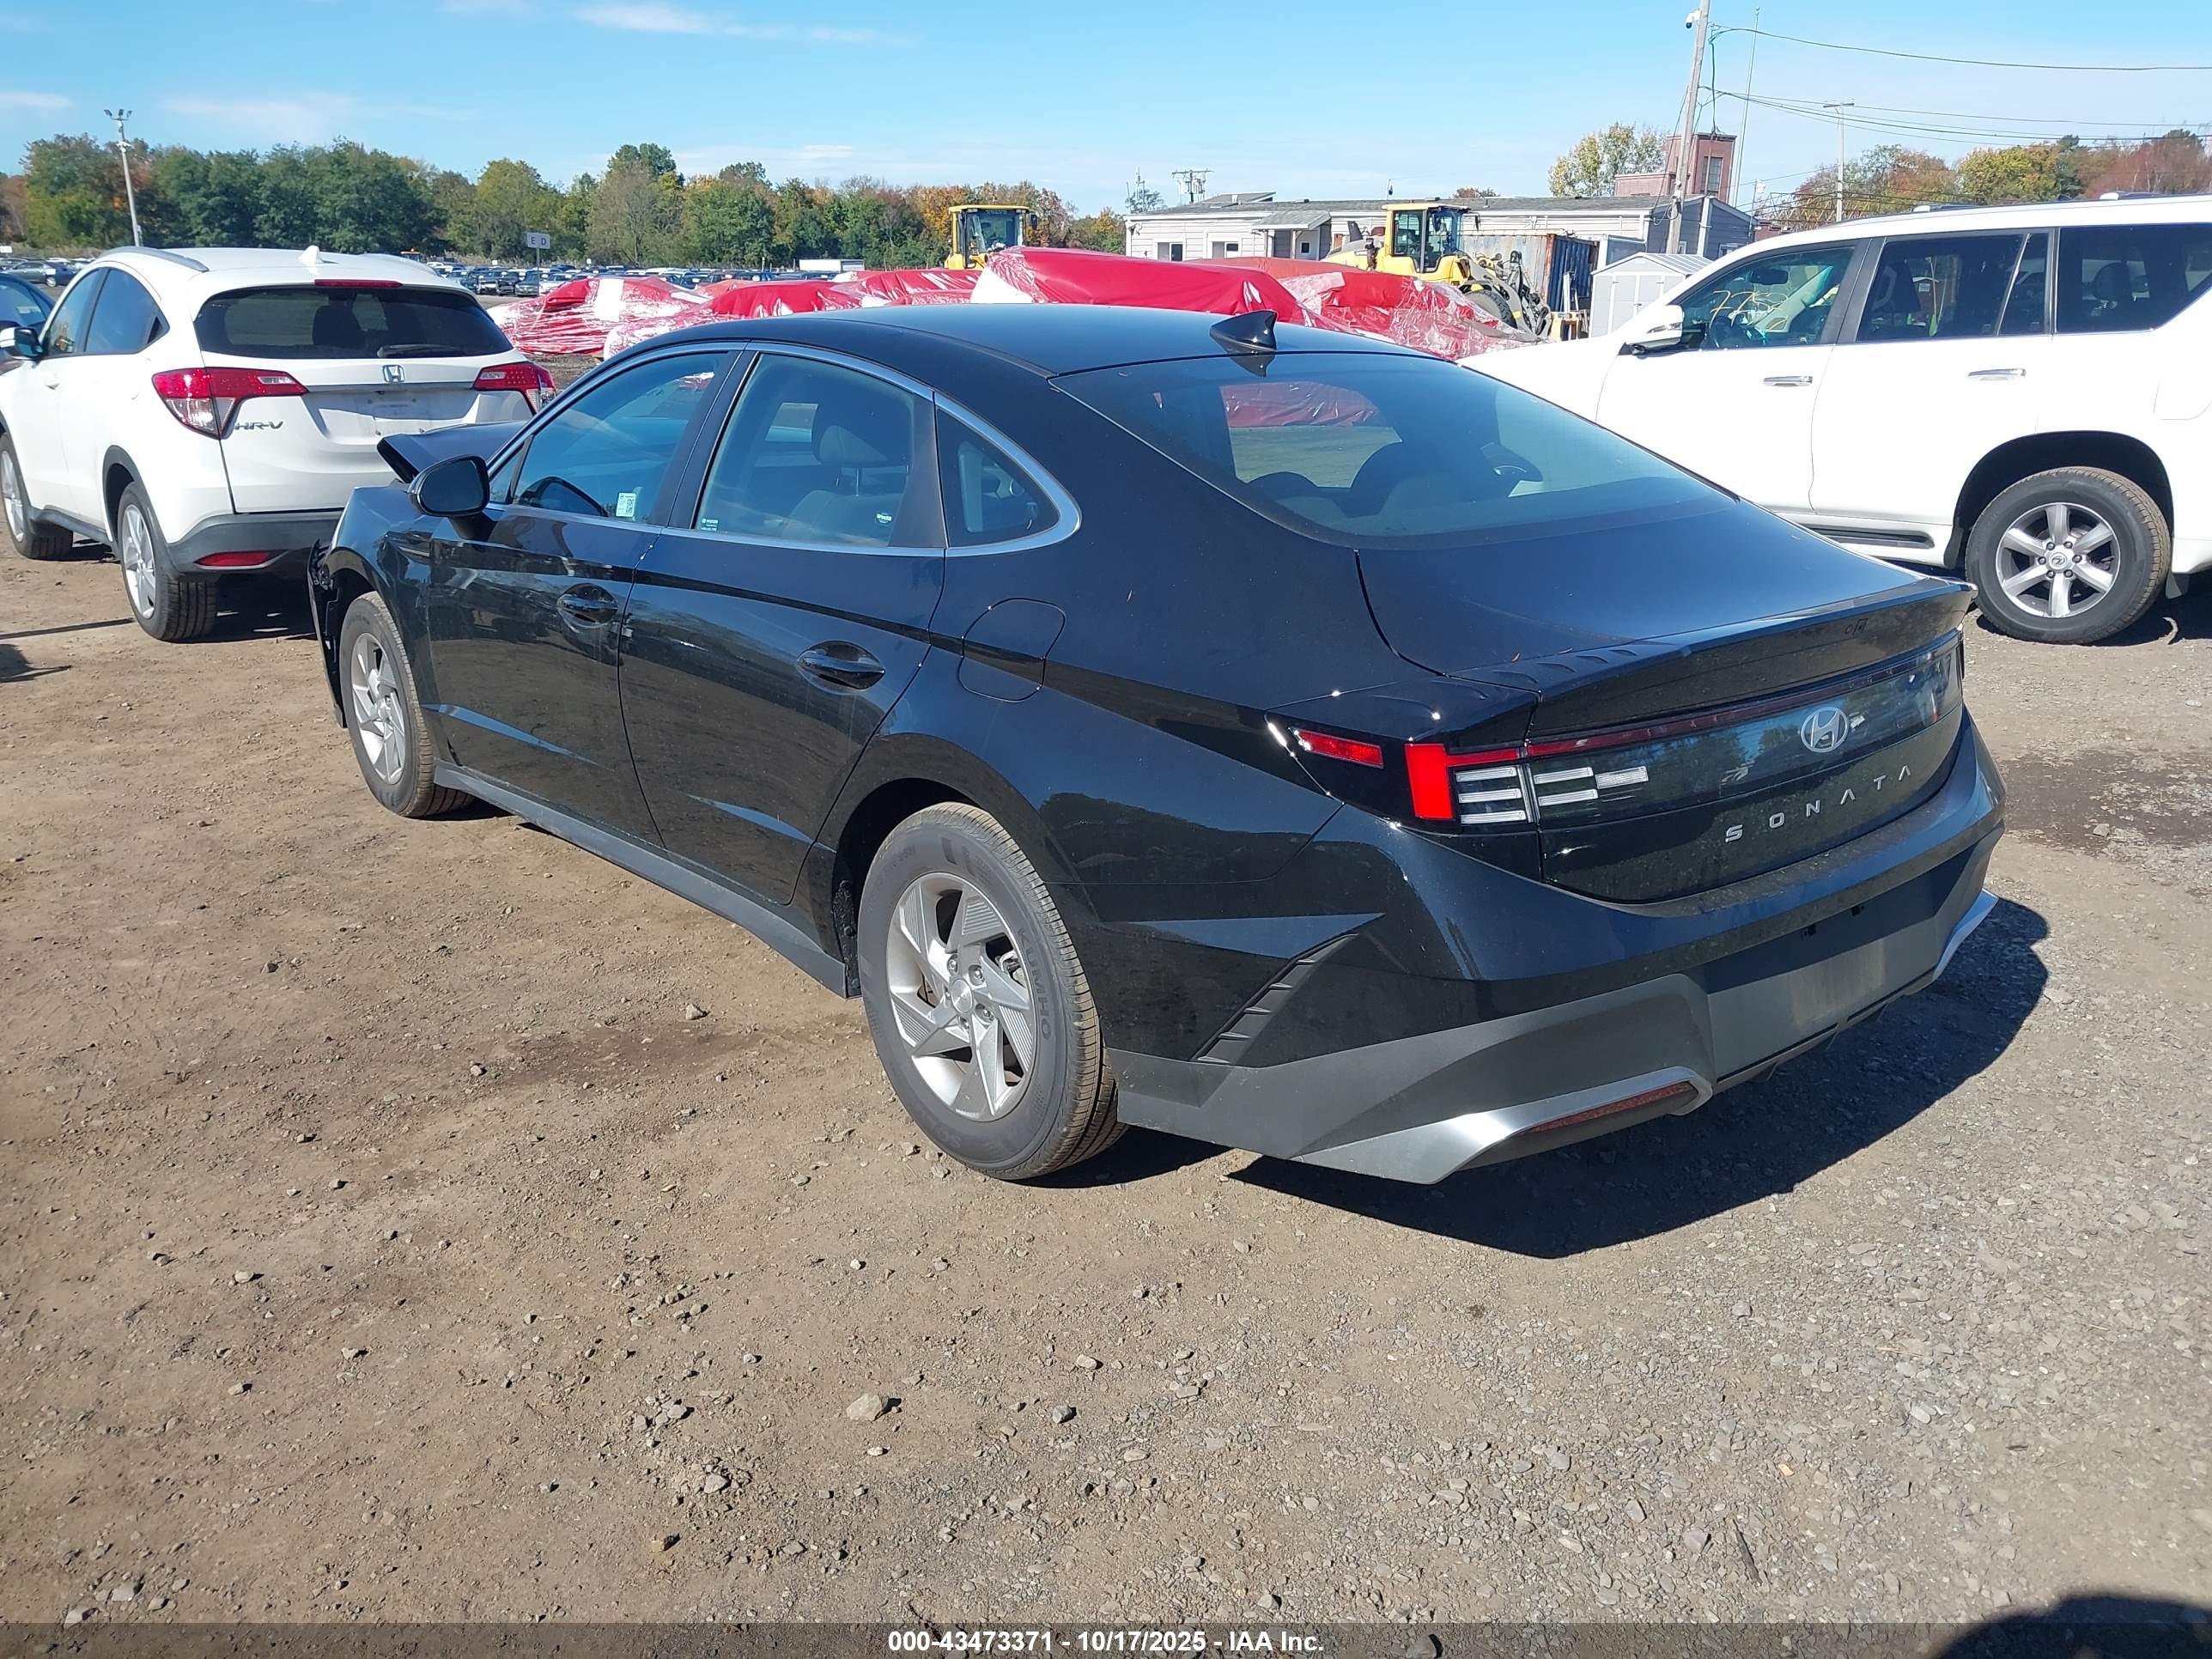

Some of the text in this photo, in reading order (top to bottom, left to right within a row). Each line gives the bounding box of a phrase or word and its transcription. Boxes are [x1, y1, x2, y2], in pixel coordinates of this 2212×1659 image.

[531, 236, 547, 246] E D
[234, 421, 283, 430] HR-V
[1725, 765, 1911, 842] SONATA
[1017, 927, 1052, 1041] KUMHO
